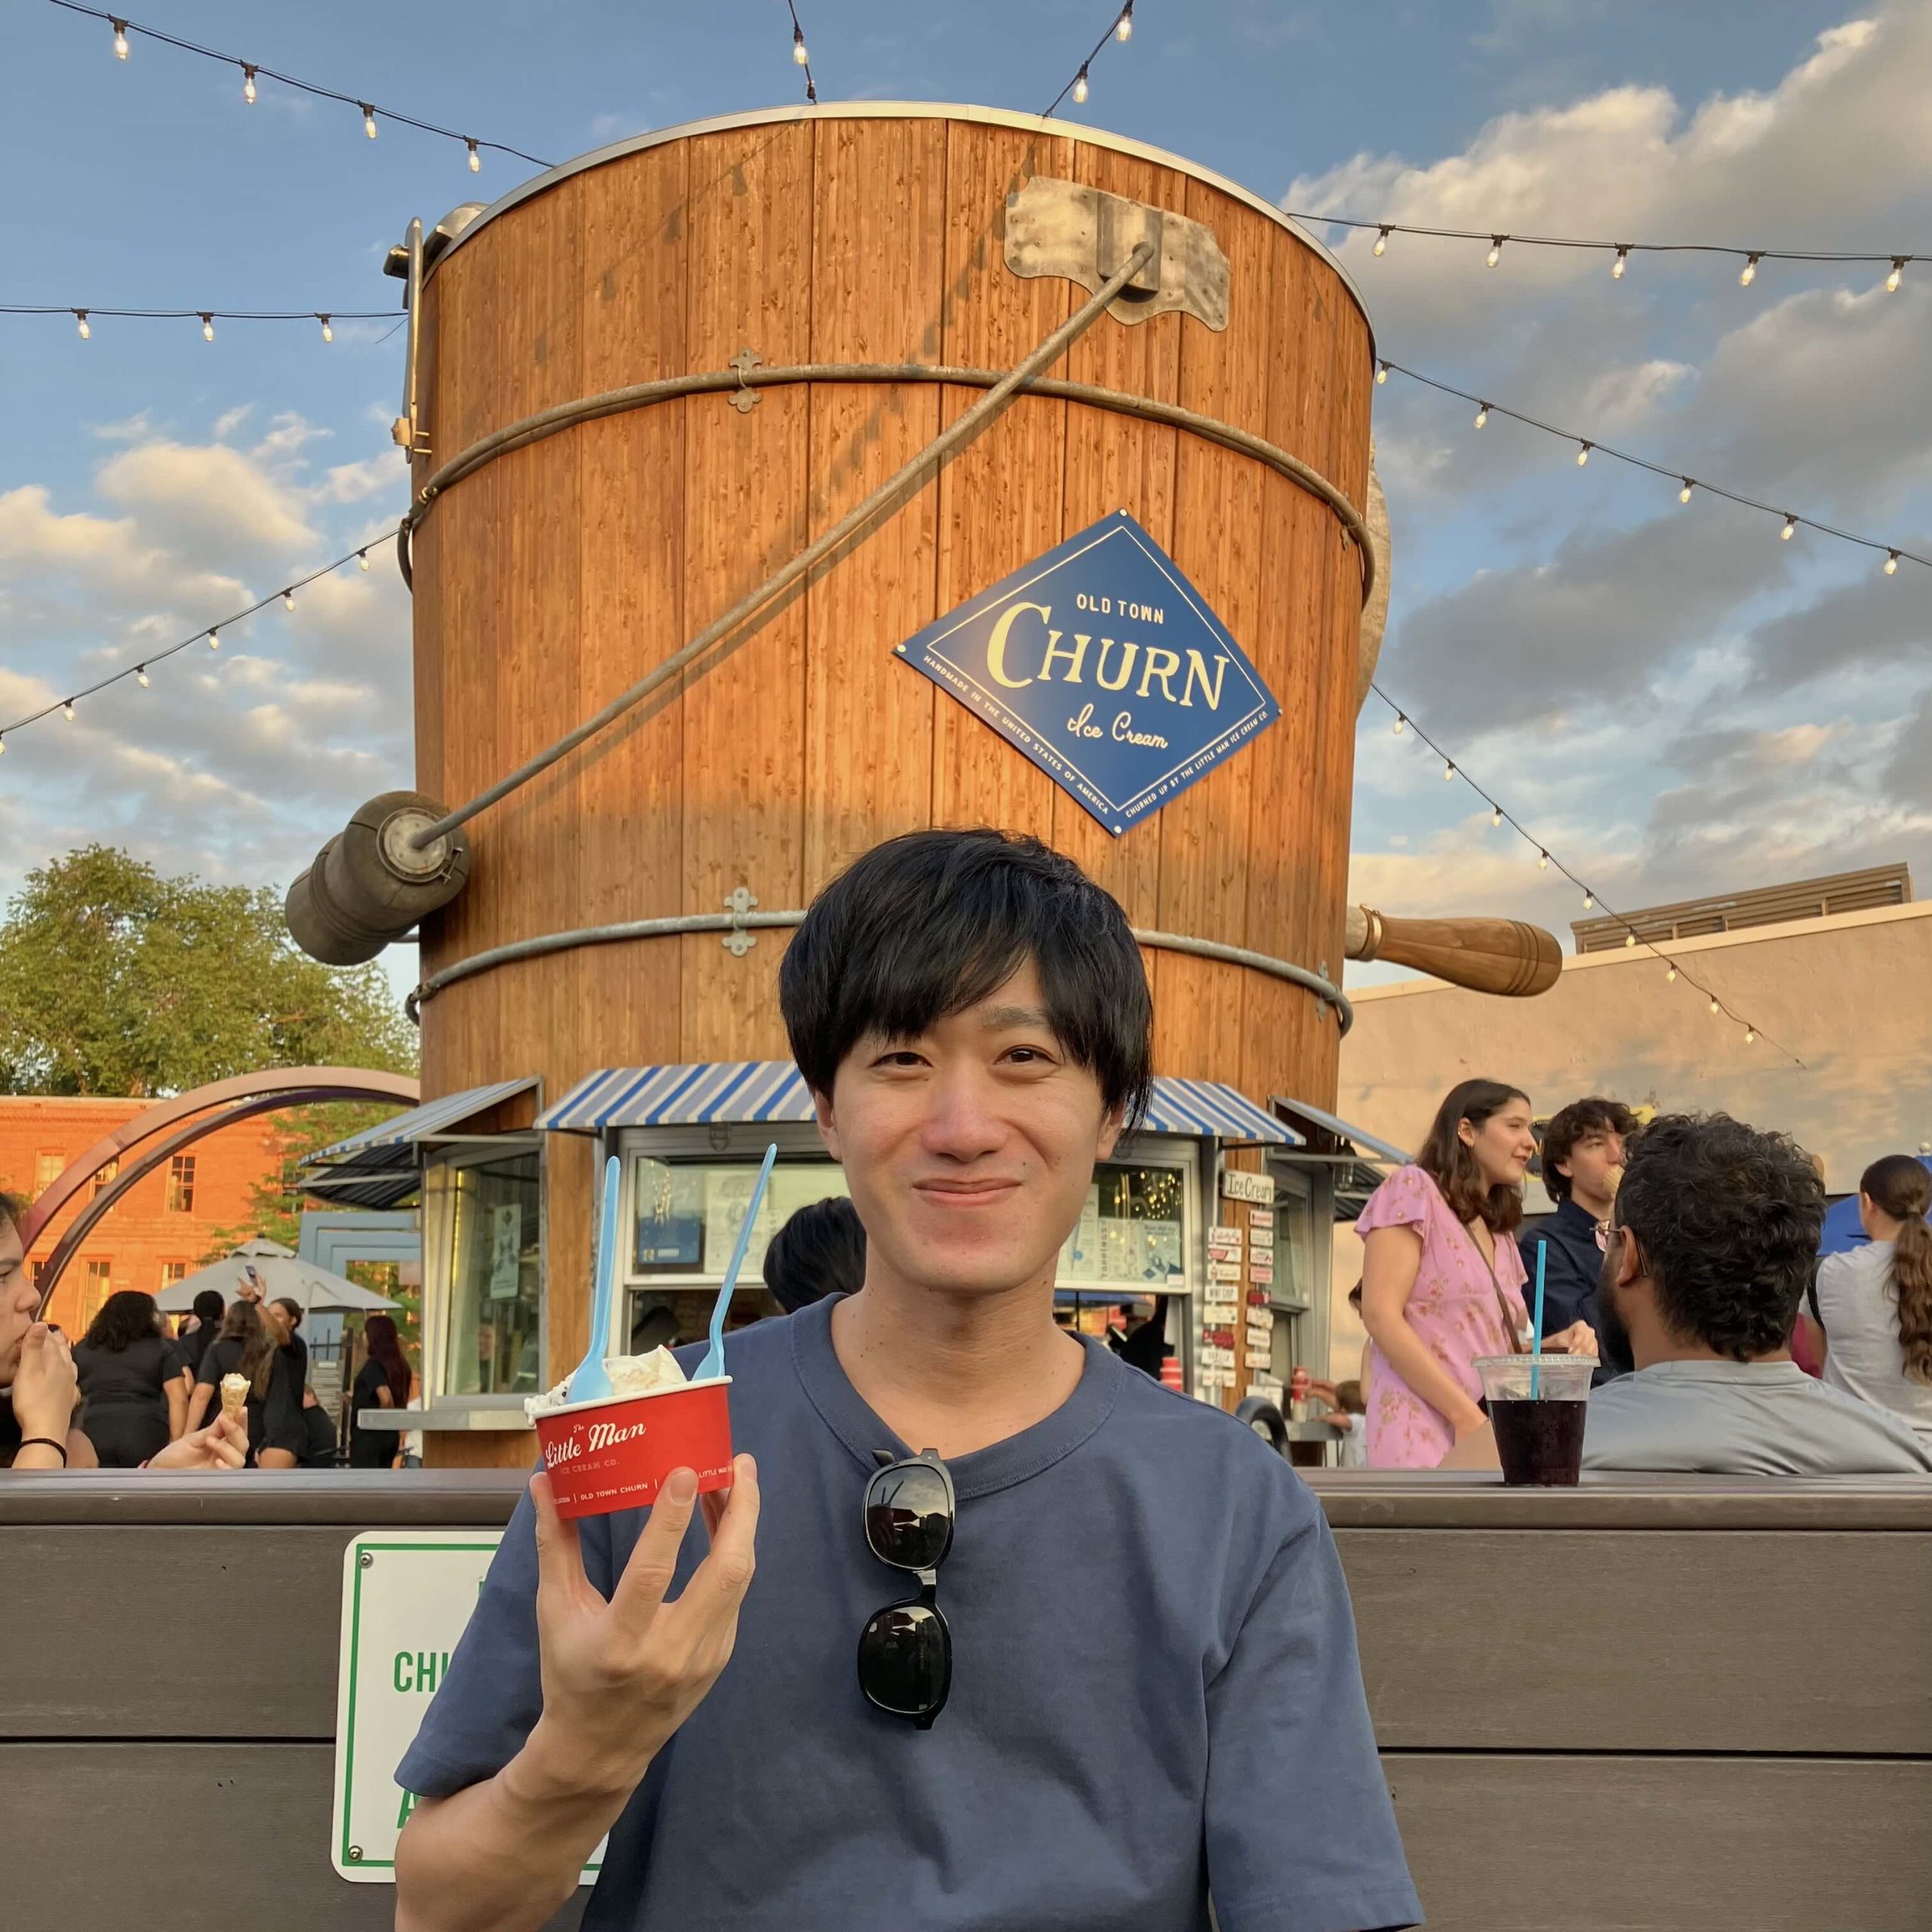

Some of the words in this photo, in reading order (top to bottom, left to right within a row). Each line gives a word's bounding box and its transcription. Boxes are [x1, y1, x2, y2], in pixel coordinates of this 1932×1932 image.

[1076, 594, 1111, 614] OLD
[1118, 600, 1164, 624] TOWN
[986, 602, 1230, 710] CHURN
[923, 655, 969, 692] HANDMADE
[971, 691, 982, 703] IN
[984, 701, 1000, 718] THE
[1001, 716, 1031, 743] UNITED
[1032, 743, 1063, 771] STATES
[1064, 771, 1076, 782] OF
[1076, 783, 1109, 815] AMERICA
[1067, 703, 1103, 737] Ice
[1112, 711, 1168, 749] Cream
[1125, 792, 1157, 818] CHURNED
[1158, 784, 1168, 795] UP
[1169, 776, 1179, 788] BY
[1180, 766, 1194, 780] THE
[1194, 750, 1216, 770] LITTLE
[1215, 740, 1230, 755] MAN
[1229, 731, 1240, 743] ICE
[1240, 718, 1259, 736] CREAM
[545, 1436, 583, 1469] Little
[588, 1423, 647, 1453] Man
[573, 1423, 585, 1434] The
[573, 1461, 601, 1473] CREAM
[604, 1459, 620, 1467] CO.
[699, 1469, 718, 1478] LITTLE
[580, 1493, 594, 1501] OLD
[596, 1489, 618, 1498] TOWN
[620, 1482, 648, 1494] CHURN
